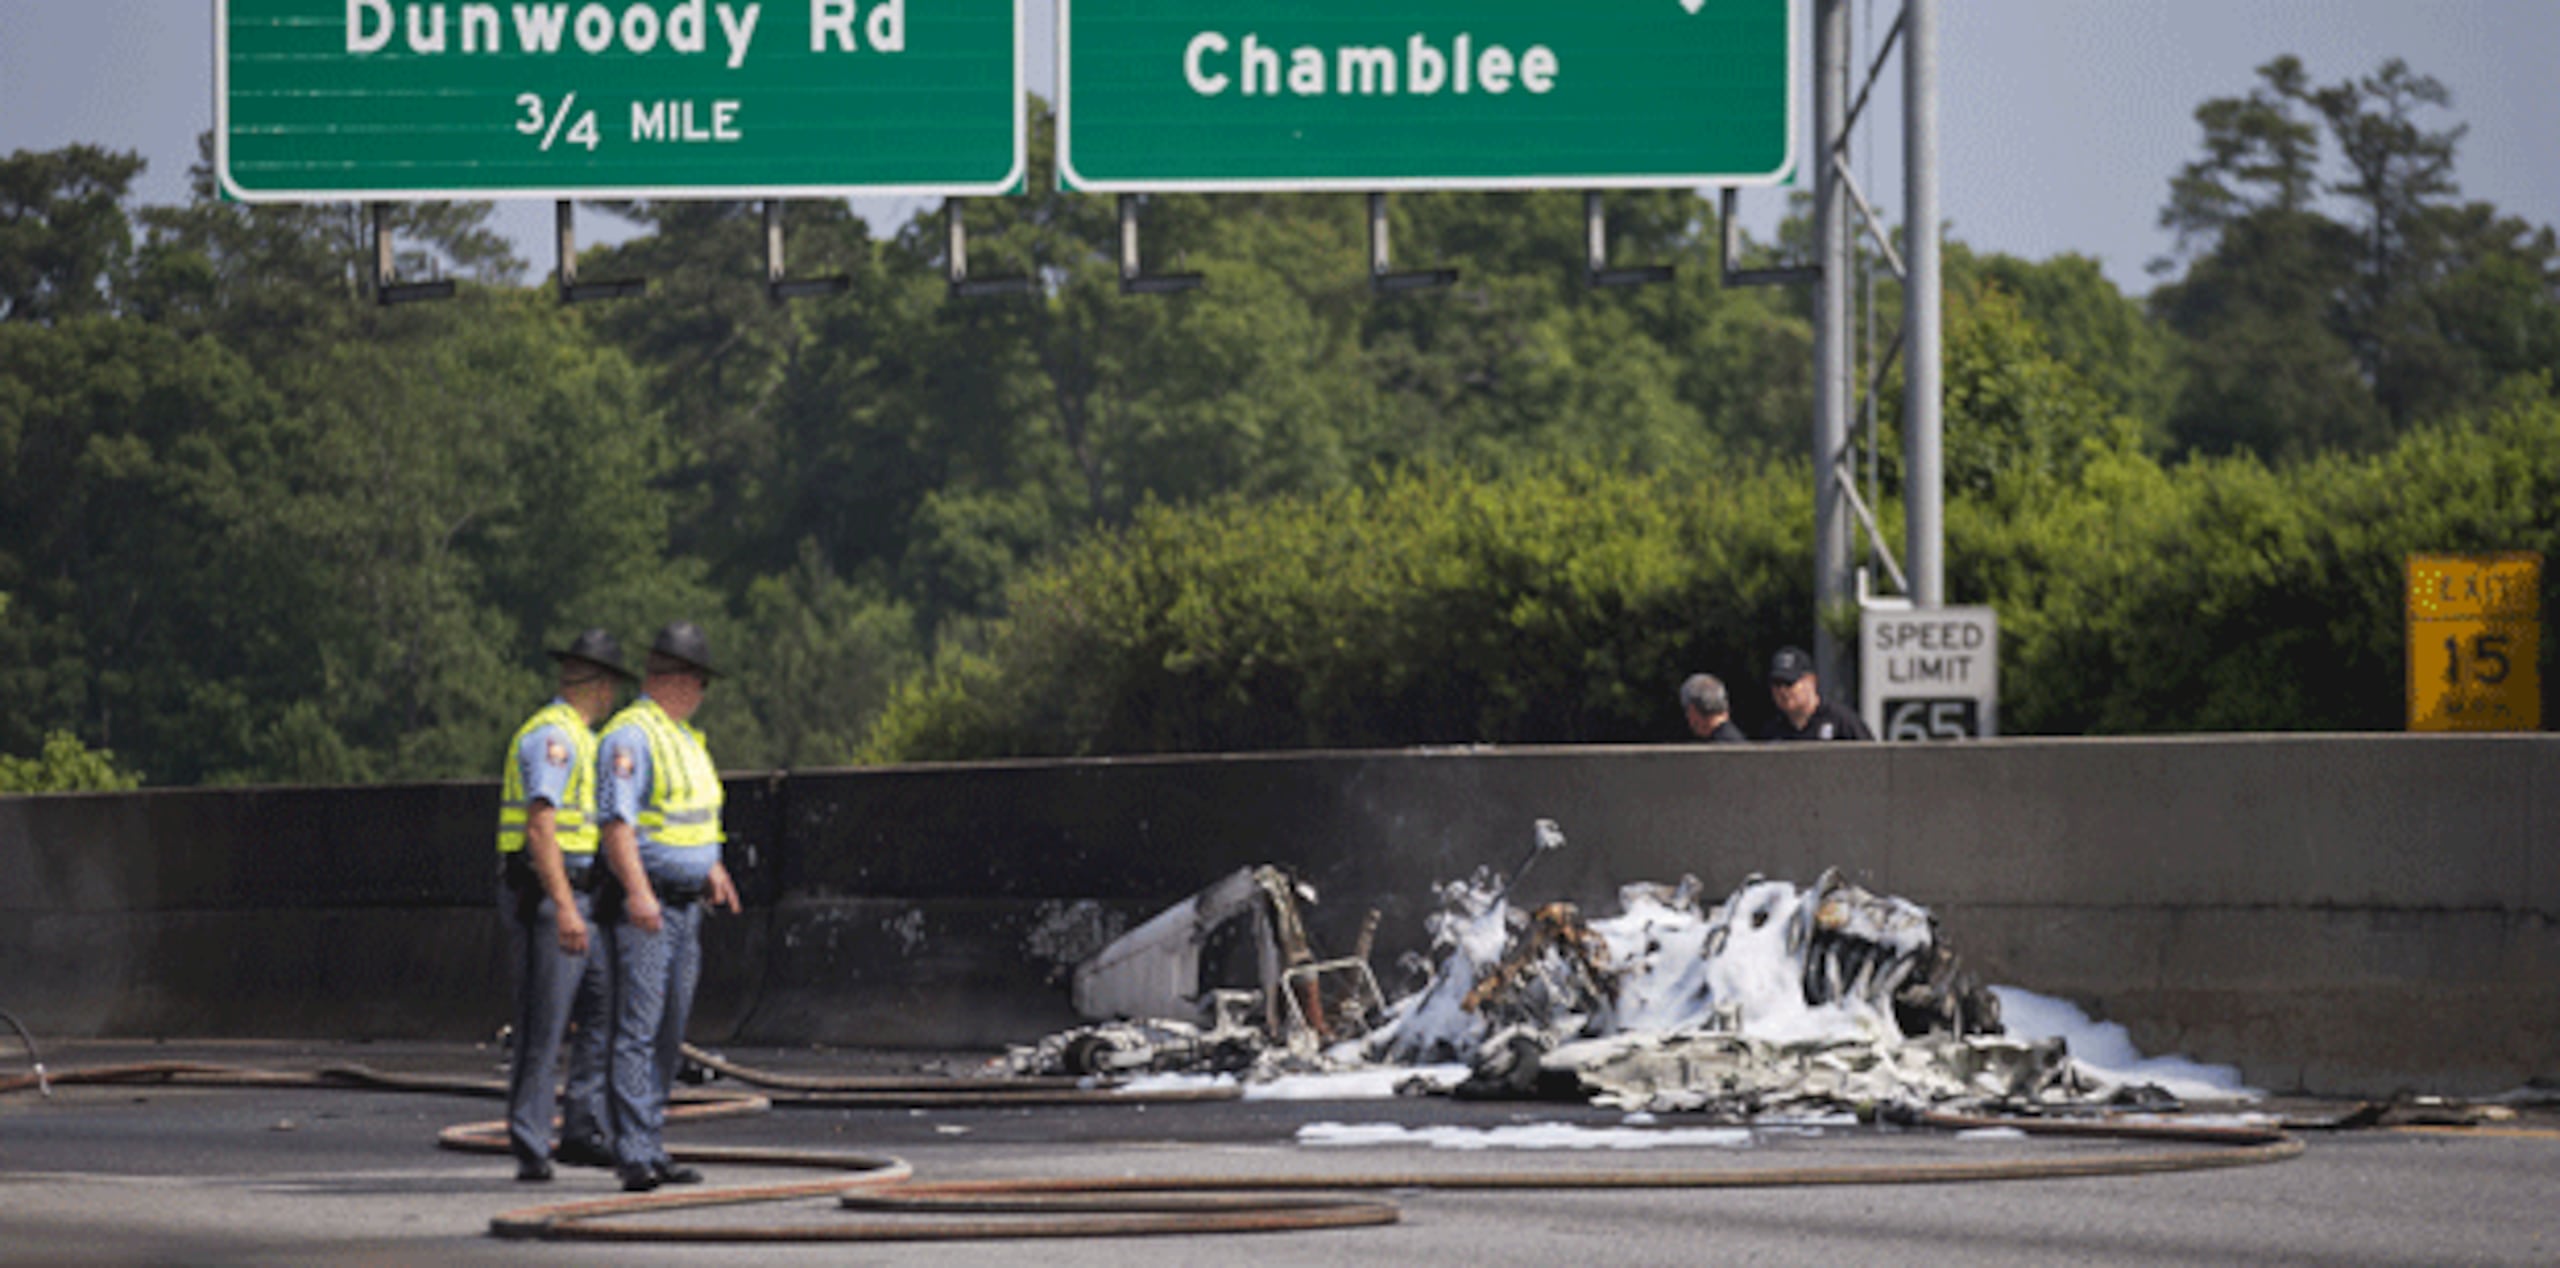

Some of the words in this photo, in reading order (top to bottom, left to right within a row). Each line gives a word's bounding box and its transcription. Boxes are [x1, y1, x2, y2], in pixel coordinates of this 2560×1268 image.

[346, 0, 761, 68] Dunwoody
[809, 0, 905, 52] Rd
[1183, 31, 1559, 95] Chamblee
[515, 92, 600, 151] 3/4
[630, 101, 742, 141] MILE
[1875, 621, 1985, 650] SPEED
[2444, 634, 2511, 684] 15
[1887, 655, 1973, 684] LIMIT
[1889, 702, 1966, 741] 65
